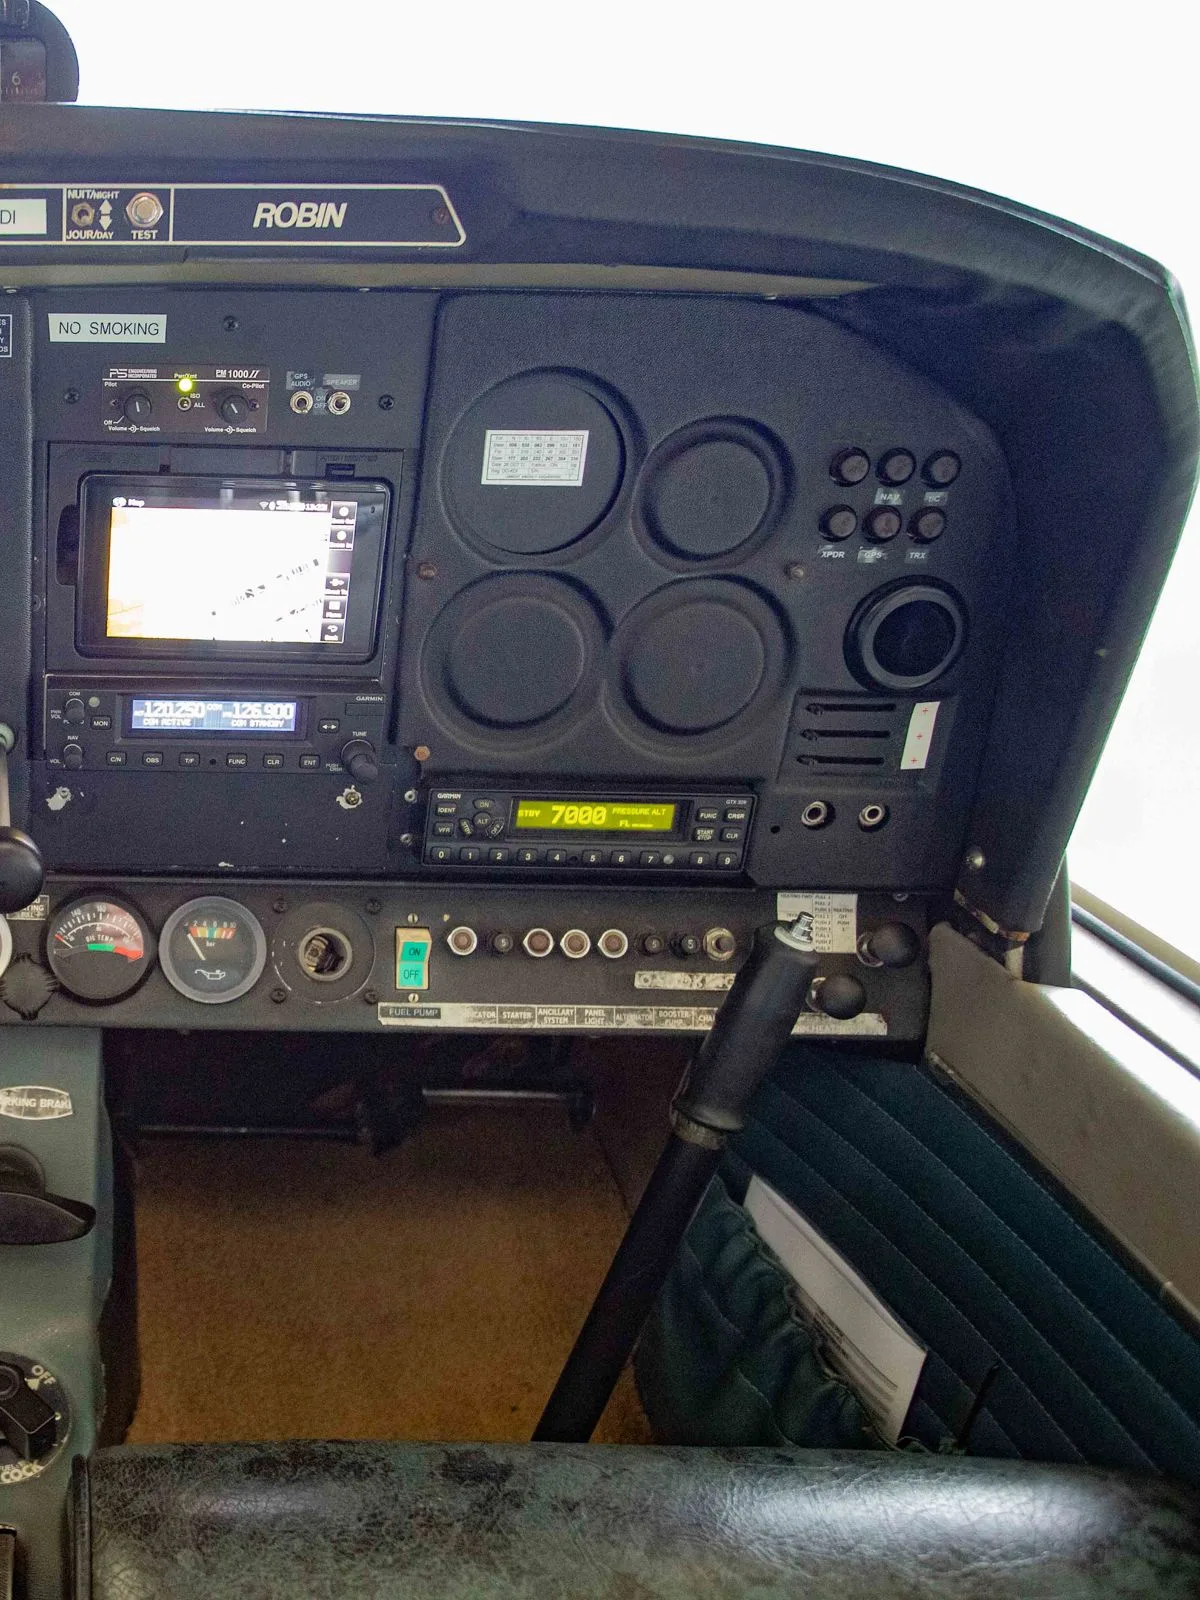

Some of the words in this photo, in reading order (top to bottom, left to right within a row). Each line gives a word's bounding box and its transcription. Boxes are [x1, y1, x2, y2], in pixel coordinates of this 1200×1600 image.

[11, 71, 21, 85] 6
[67, 189, 120, 199] NUIT/NIGHT
[252, 202, 348, 228] ROBIN
[66, 229, 114, 240] JOUR/DAY
[131, 230, 158, 240] TEST
[59, 321, 81, 335] NO
[89, 321, 159, 335] SMOKING
[551, 804, 607, 825] 7000
[612, 807, 650, 815] PRESSURE
[438, 850, 445, 859] 0
[724, 857, 731, 865] 9
[408, 946, 421, 957] ON
[403, 968, 420, 980] OFF
[389, 1008, 411, 1016] FUEL
[413, 1009, 438, 1017] PUMP
[502, 1011, 532, 1019] STARTER
[659, 1010, 688, 1018] BOOSTER
[31, 1364, 57, 1385] OFF
[0, 1461, 44, 1483] COCK
